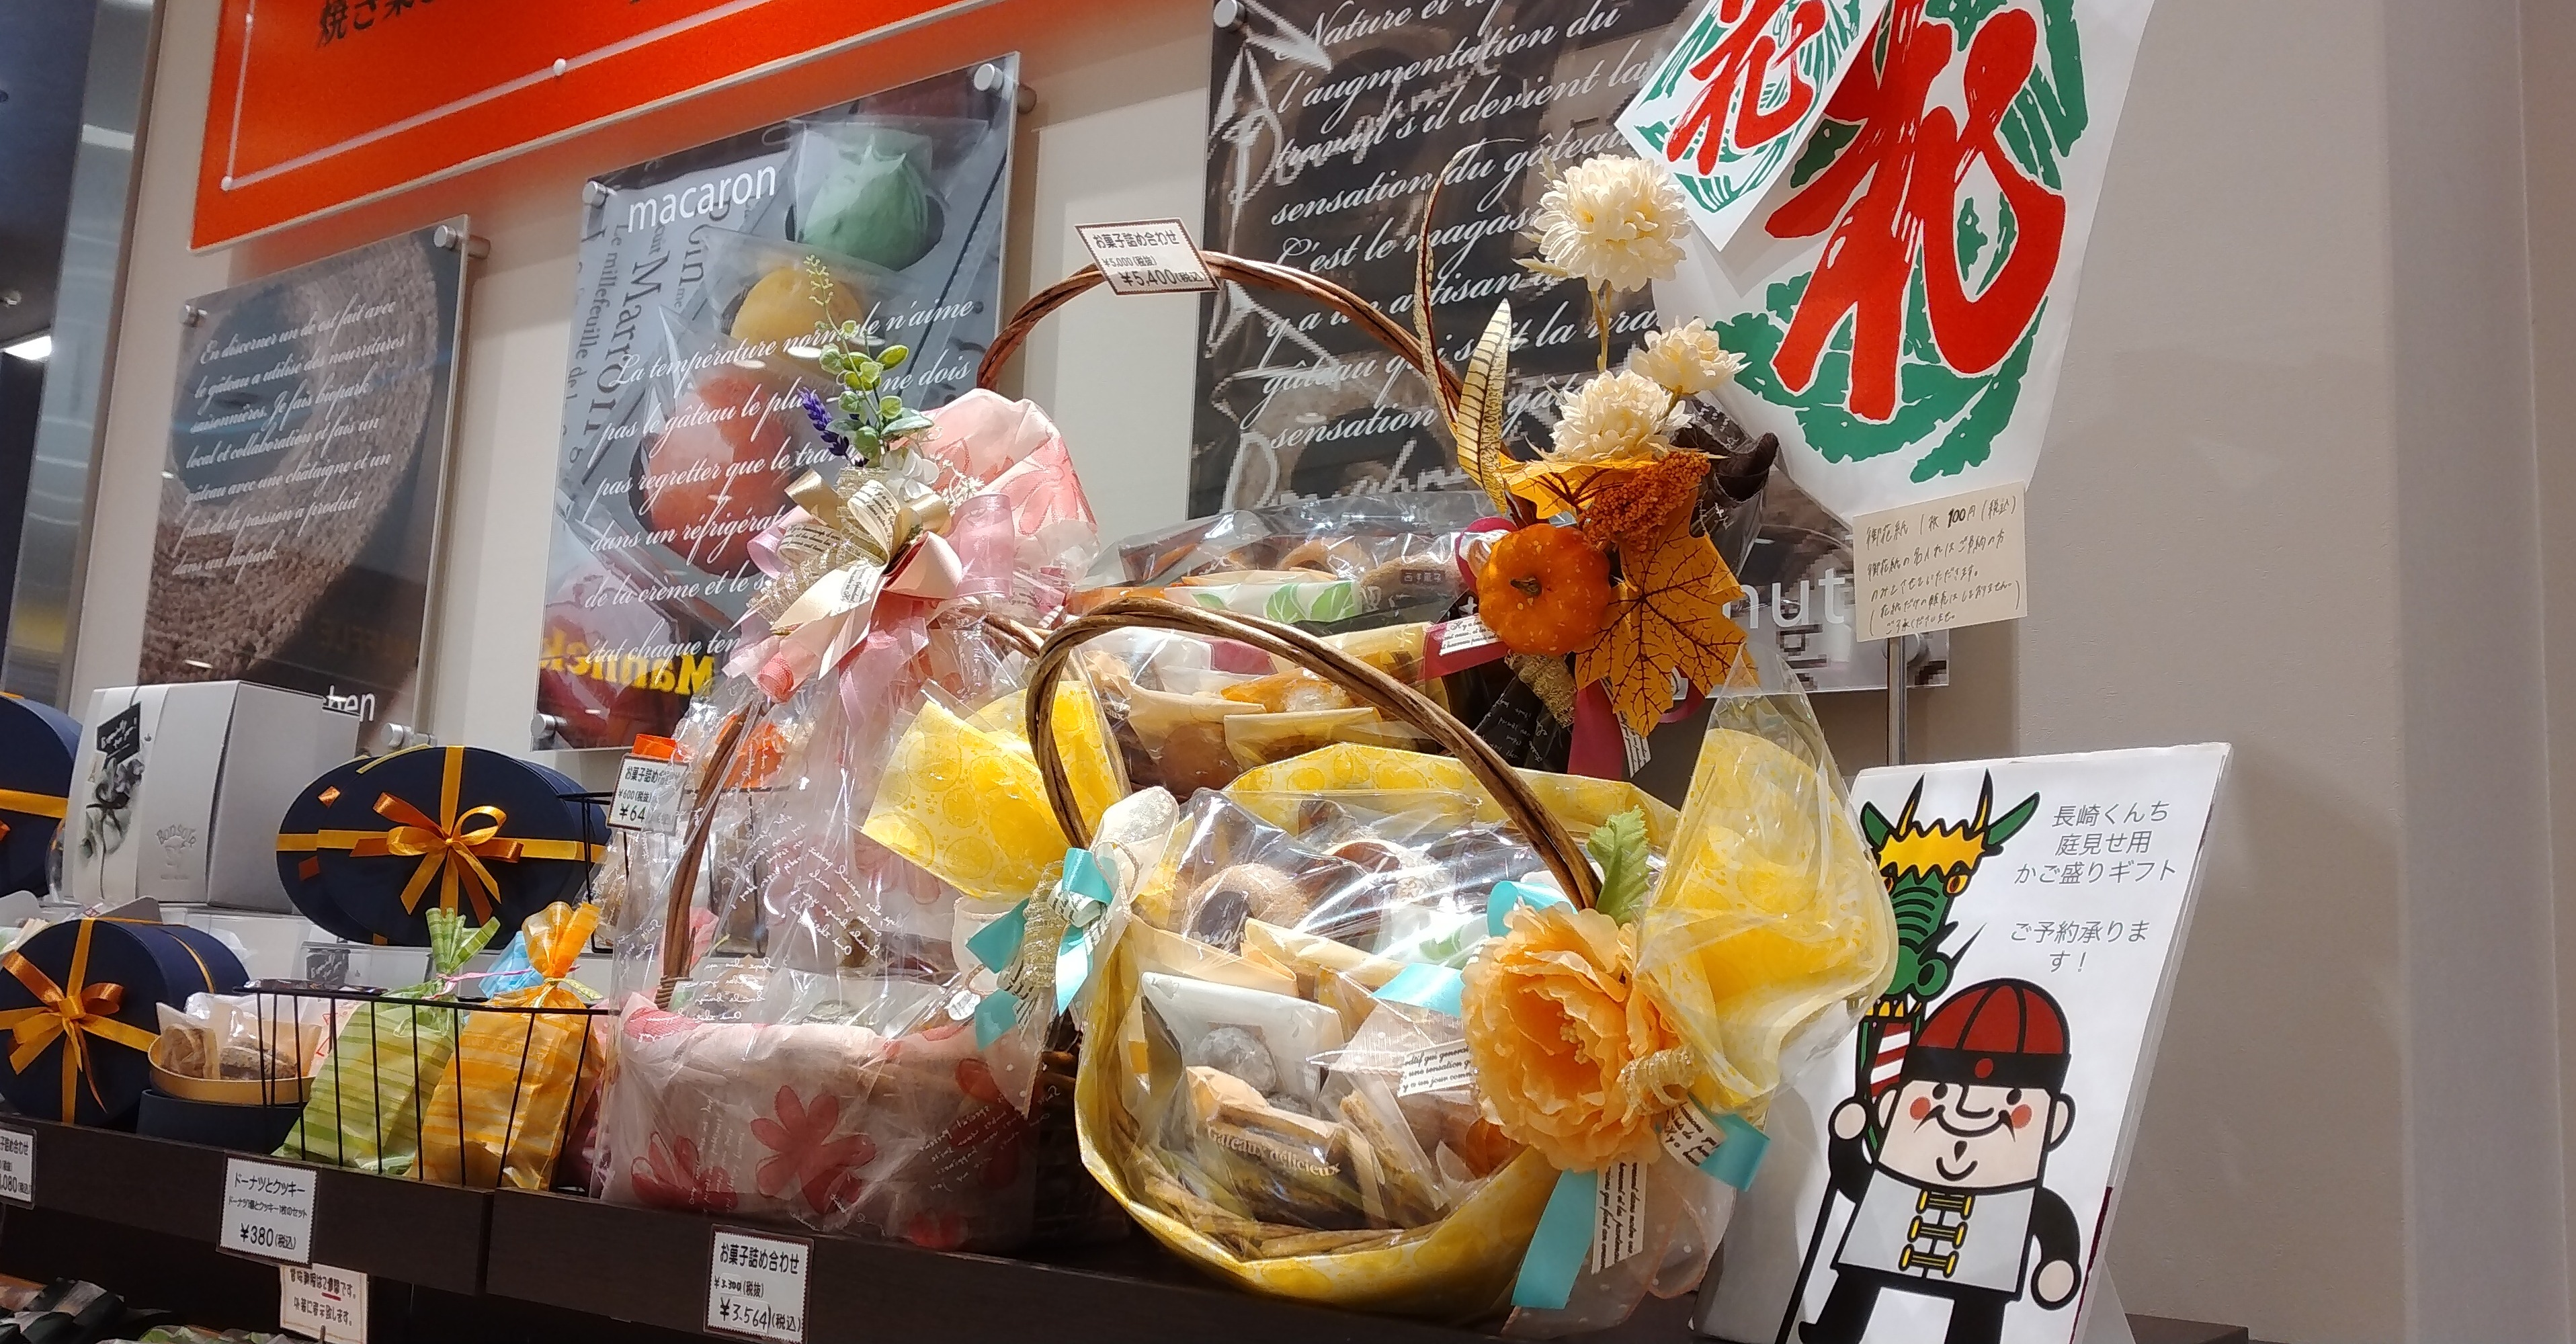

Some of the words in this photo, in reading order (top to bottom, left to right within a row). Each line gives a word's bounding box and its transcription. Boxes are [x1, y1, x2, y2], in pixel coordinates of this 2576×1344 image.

[1309, 0, 1413, 47] Nature
[1277, 24, 1559, 134] l'augmentation
[1566, 0, 1621, 39] du
[1275, 100, 1388, 169] travail
[1395, 85, 1466, 140] s'il
[1458, 59, 1606, 124] devient
[1608, 39, 1649, 87] la
[628, 164, 777, 233] macaron
[1271, 169, 1438, 226] sensation
[1444, 136, 1496, 186] du
[1093, 229, 1180, 249] お菓子詰め合わせ
[1276, 235, 1364, 274] C'est
[1364, 216, 1399, 262] le
[1404, 208, 1534, 280] magas
[1298, 310, 1323, 331] a
[1389, 272, 1524, 314] atisan
[1536, 300, 1577, 347] la
[608, 353, 646, 388] La
[649, 336, 778, 399] température
[782, 301, 881, 353] normle
[886, 300, 974, 332] n'aime
[917, 349, 972, 386] dois
[741, 384, 762, 417] le
[882, 373, 913, 392] ne
[642, 402, 662, 438] le
[649, 402, 738, 460] gâteau
[751, 376, 804, 442] plu
[1271, 403, 1438, 450] sensation
[587, 422, 638, 469] pas
[582, 476, 634, 523] pas
[638, 458, 722, 515] regretter
[716, 456, 766, 505] que
[770, 437, 792, 470] le
[591, 520, 641, 552] dans
[646, 528, 677, 546] un
[585, 575, 609, 608] de
[612, 573, 638, 605] la
[638, 575, 700, 603] crème
[705, 572, 731, 596] et
[729, 560, 751, 595] le
[585, 639, 628, 665] état
[628, 619, 704, 686] chaque
[619, 802, 647, 823] ¥64
[2052, 800, 2169, 827] 長崎くんち
[2055, 831, 2152, 856] 庭見せ用
[2014, 859, 2175, 884] かご盛りギフト
[2011, 920, 2150, 943] ご予約承りま
[235, 1172, 306, 1198] ドーナツとクッキー
[240, 1222, 297, 1250] ¥380(税込)
[720, 1242, 800, 1275] お菓子詰め合わせ
